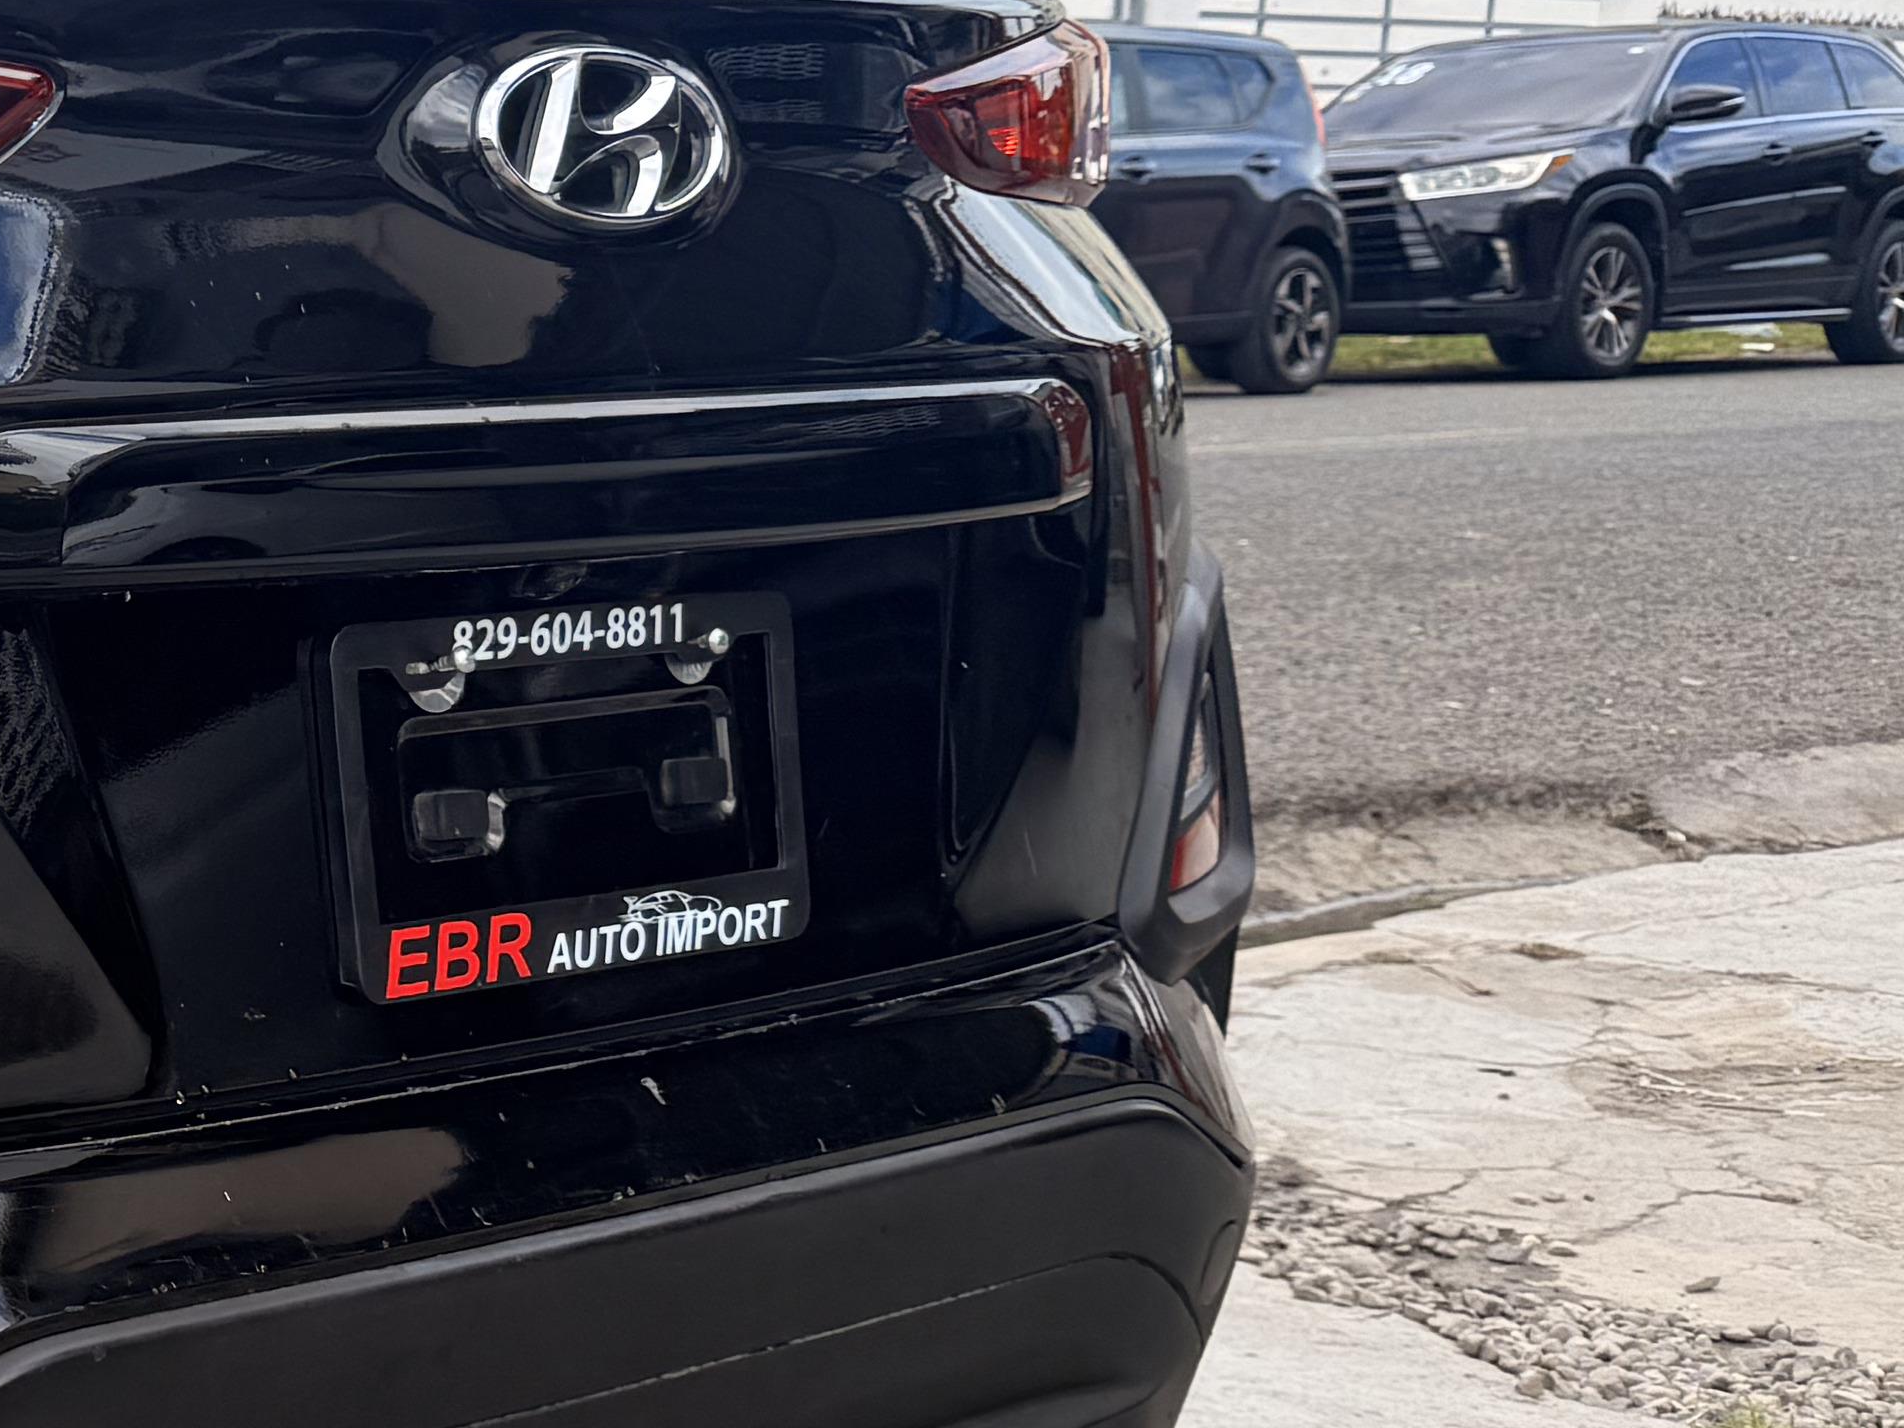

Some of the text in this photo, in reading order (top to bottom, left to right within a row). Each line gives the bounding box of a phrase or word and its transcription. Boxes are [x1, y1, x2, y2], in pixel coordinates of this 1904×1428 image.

[452, 602, 685, 662] 829-604-8811
[385, 899, 790, 1000] EBR AUTO IMPORT
